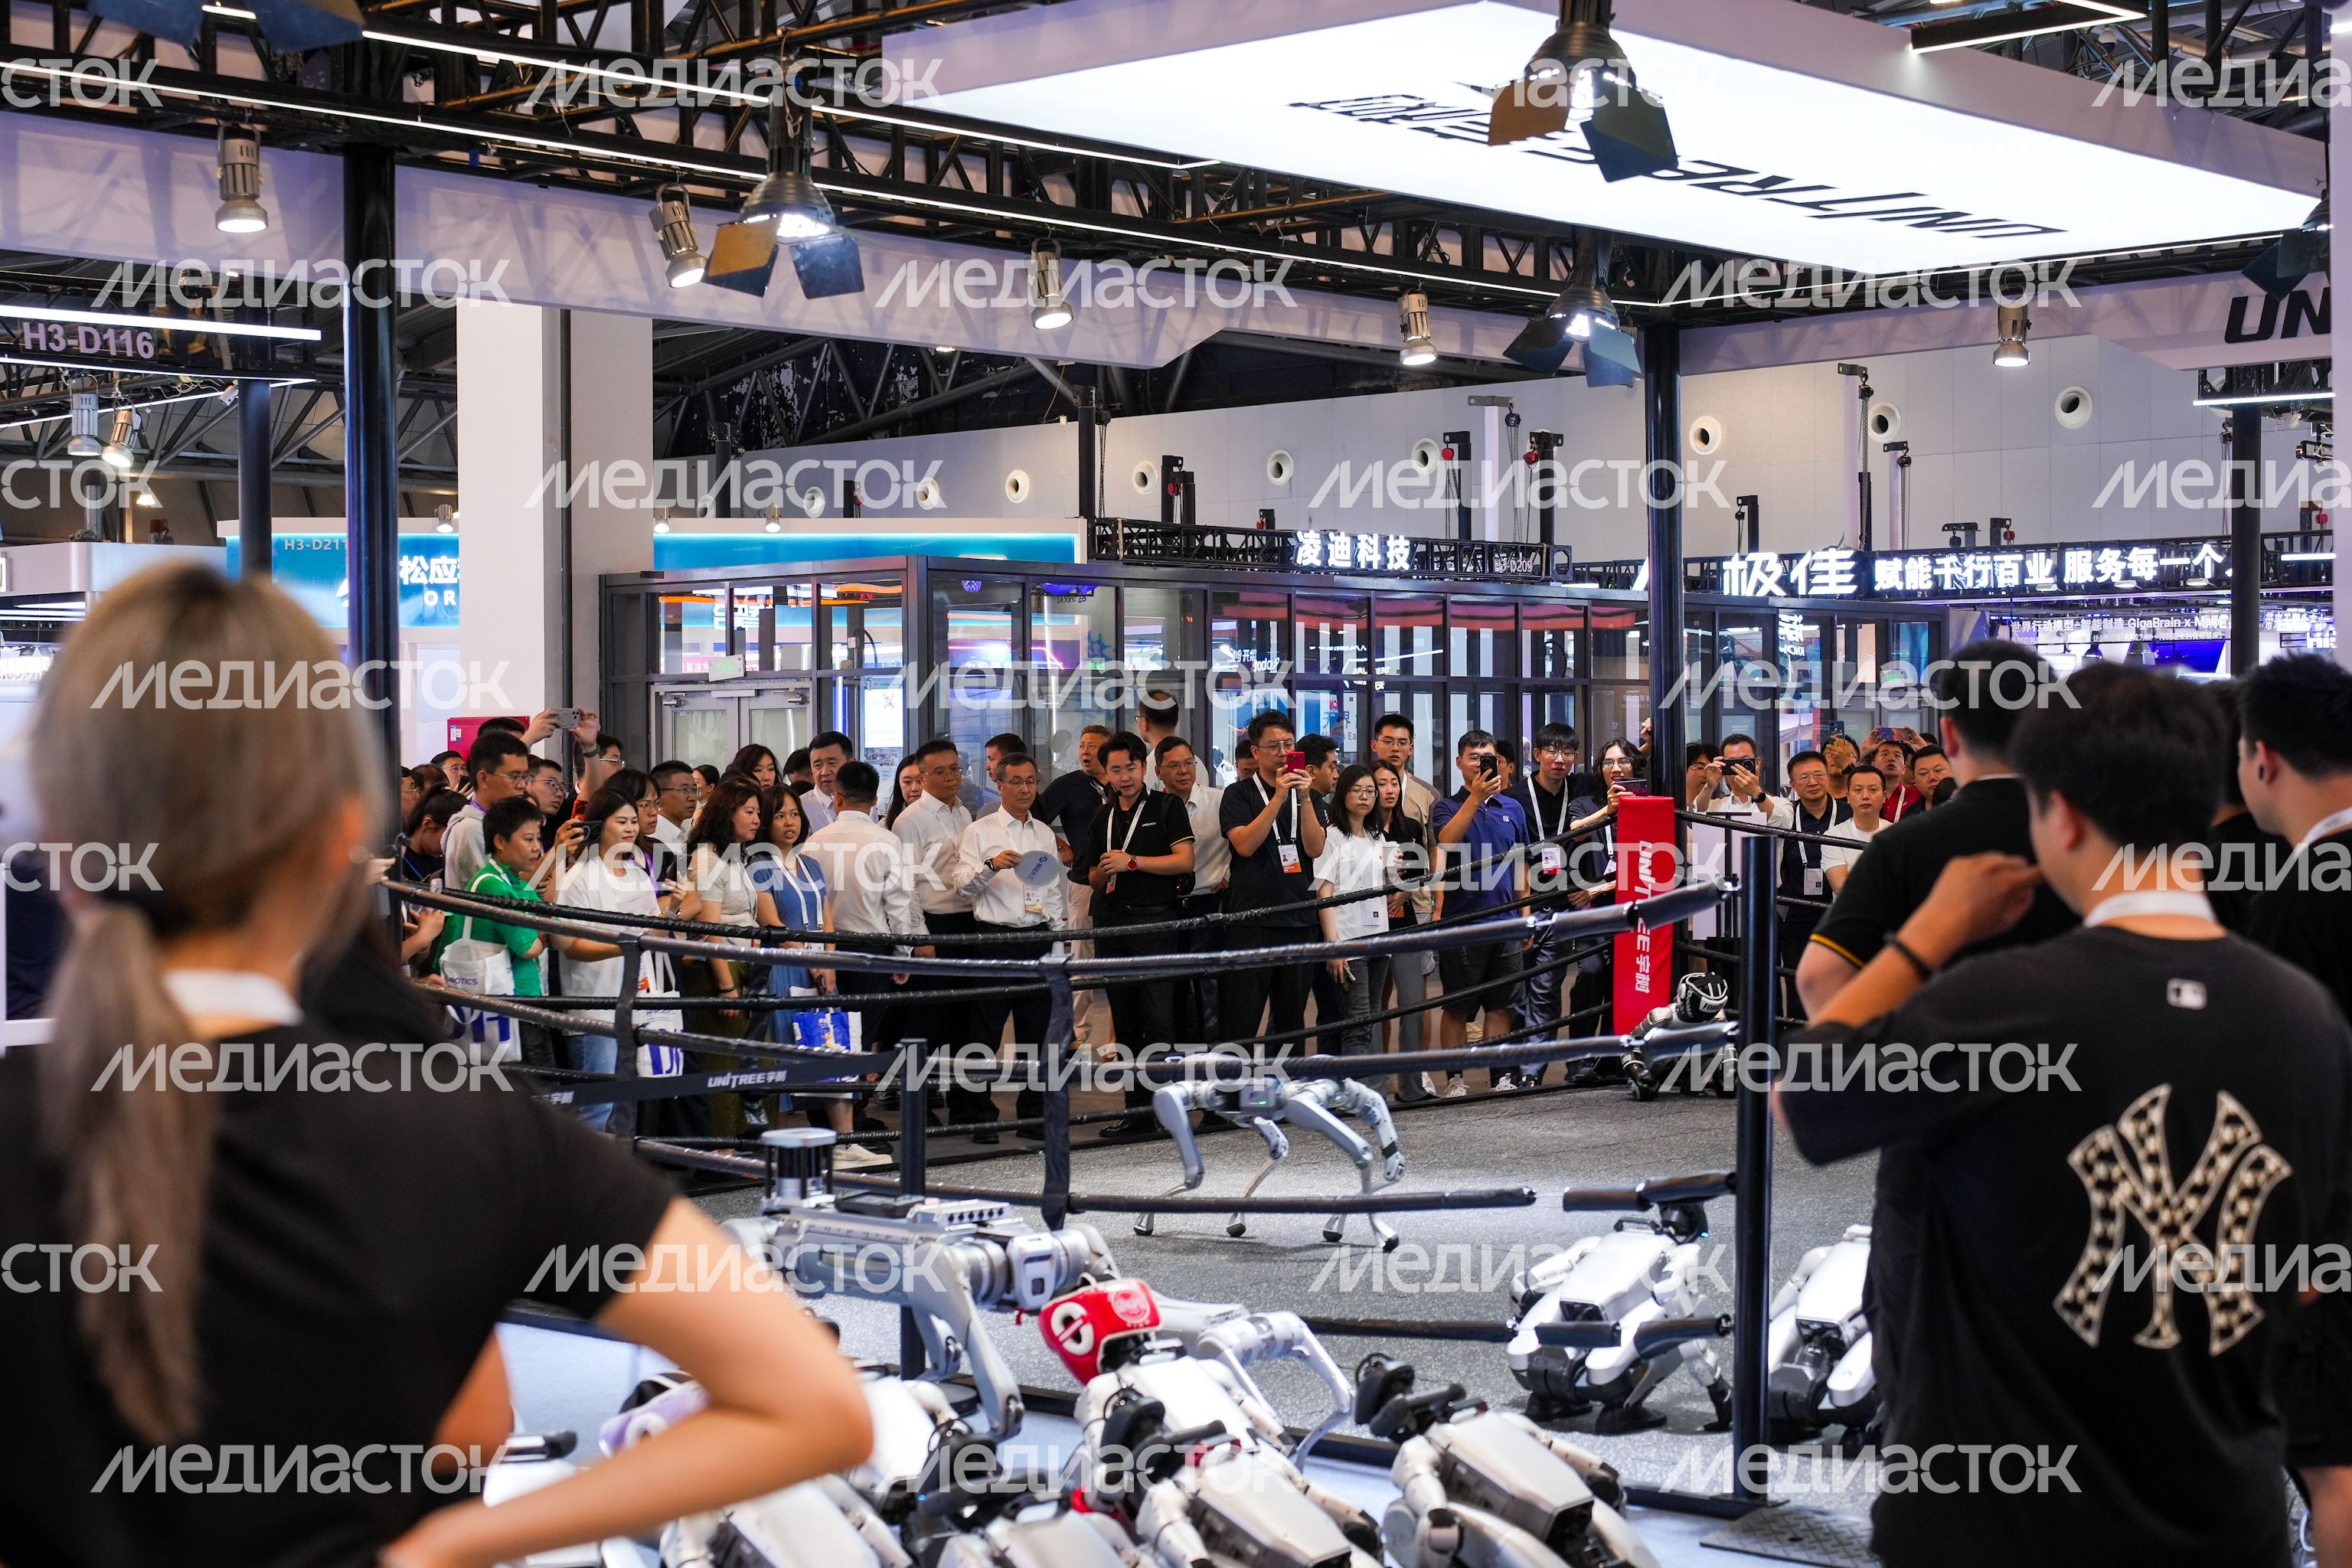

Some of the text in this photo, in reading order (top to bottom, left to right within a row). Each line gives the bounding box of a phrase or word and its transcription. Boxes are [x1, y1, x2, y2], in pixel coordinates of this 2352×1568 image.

[21, 321, 155, 360] H3-D116
[400, 555, 459, 585] 松应
[1296, 530, 1410, 570] 凌迪科技
[1874, 544, 2232, 590] 赋能千行百业 服务每一个
[1723, 548, 1859, 596] 极佳
[2128, 617, 2181, 629] GigaBrain
[1635, 841, 1655, 952] UNITEE
